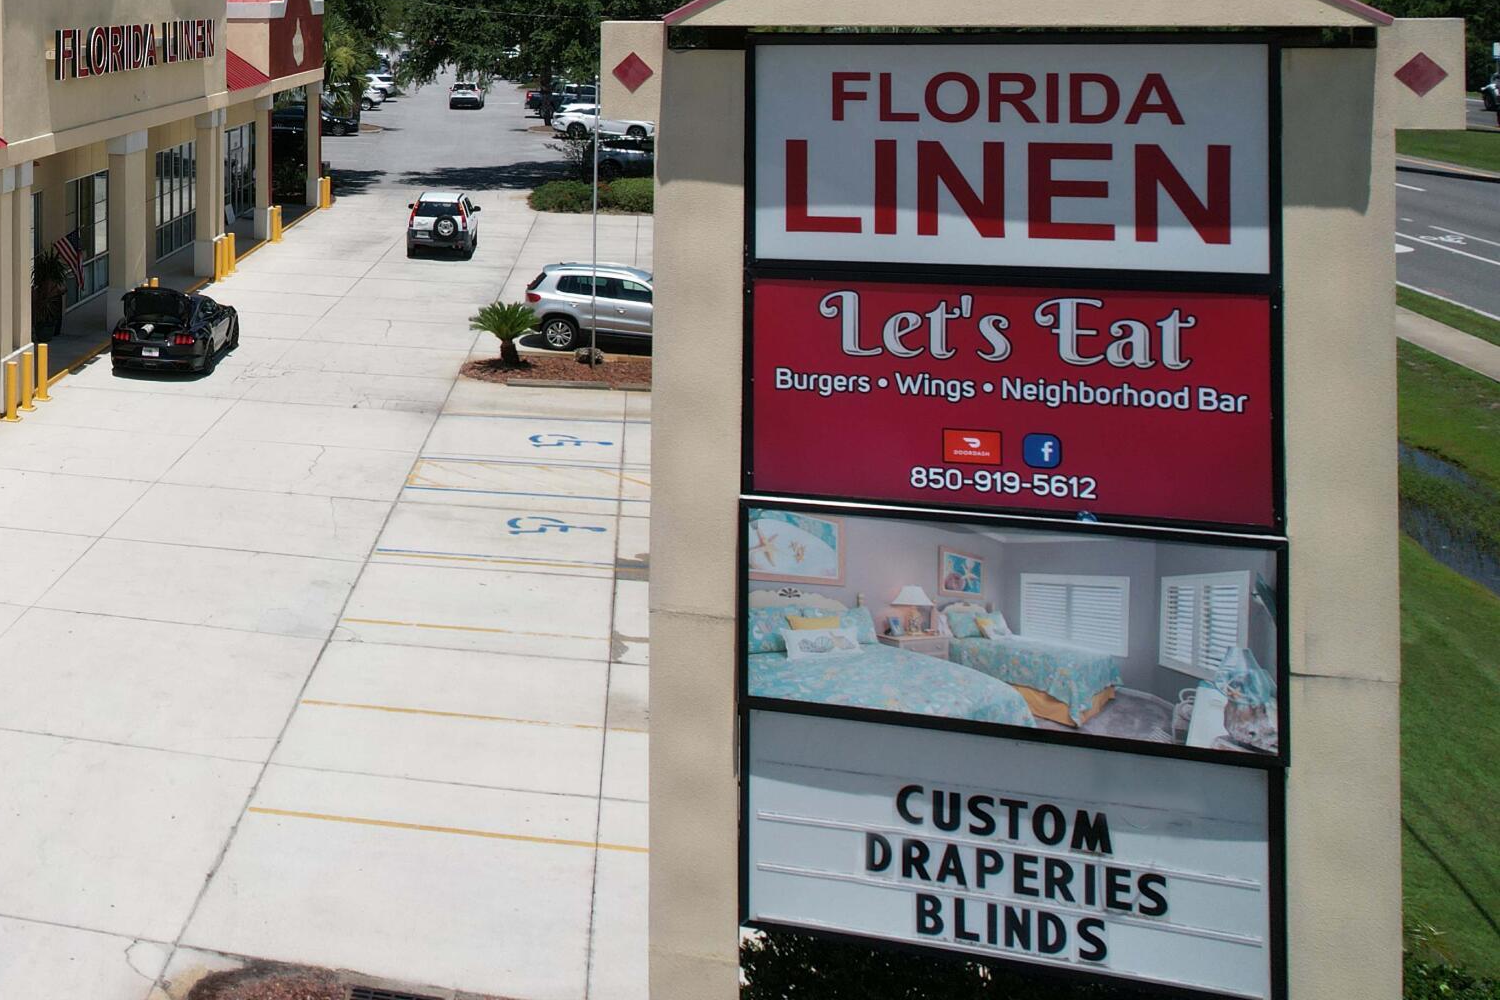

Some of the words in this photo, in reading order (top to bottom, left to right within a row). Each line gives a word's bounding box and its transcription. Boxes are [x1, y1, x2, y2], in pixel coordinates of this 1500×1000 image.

[59, 23, 157, 80] FLORIDA
[166, 19, 215, 63] LINEN
[832, 71, 1186, 126] FLORIDA
[785, 138, 1232, 245] LINEN
[819, 289, 1013, 362] Let's
[1034, 296, 1197, 371] Eat
[775, 367, 871, 398] Burgers
[895, 372, 976, 403] Wings
[1001, 376, 1190, 411] Neighborhood
[1198, 387, 1248, 413] Bar
[909, 465, 1098, 500] 850-919-5612
[895, 784, 1114, 855] CUSTOM
[865, 831, 1169, 917] DRAPERIES
[916, 893, 1109, 962] BLINDS
